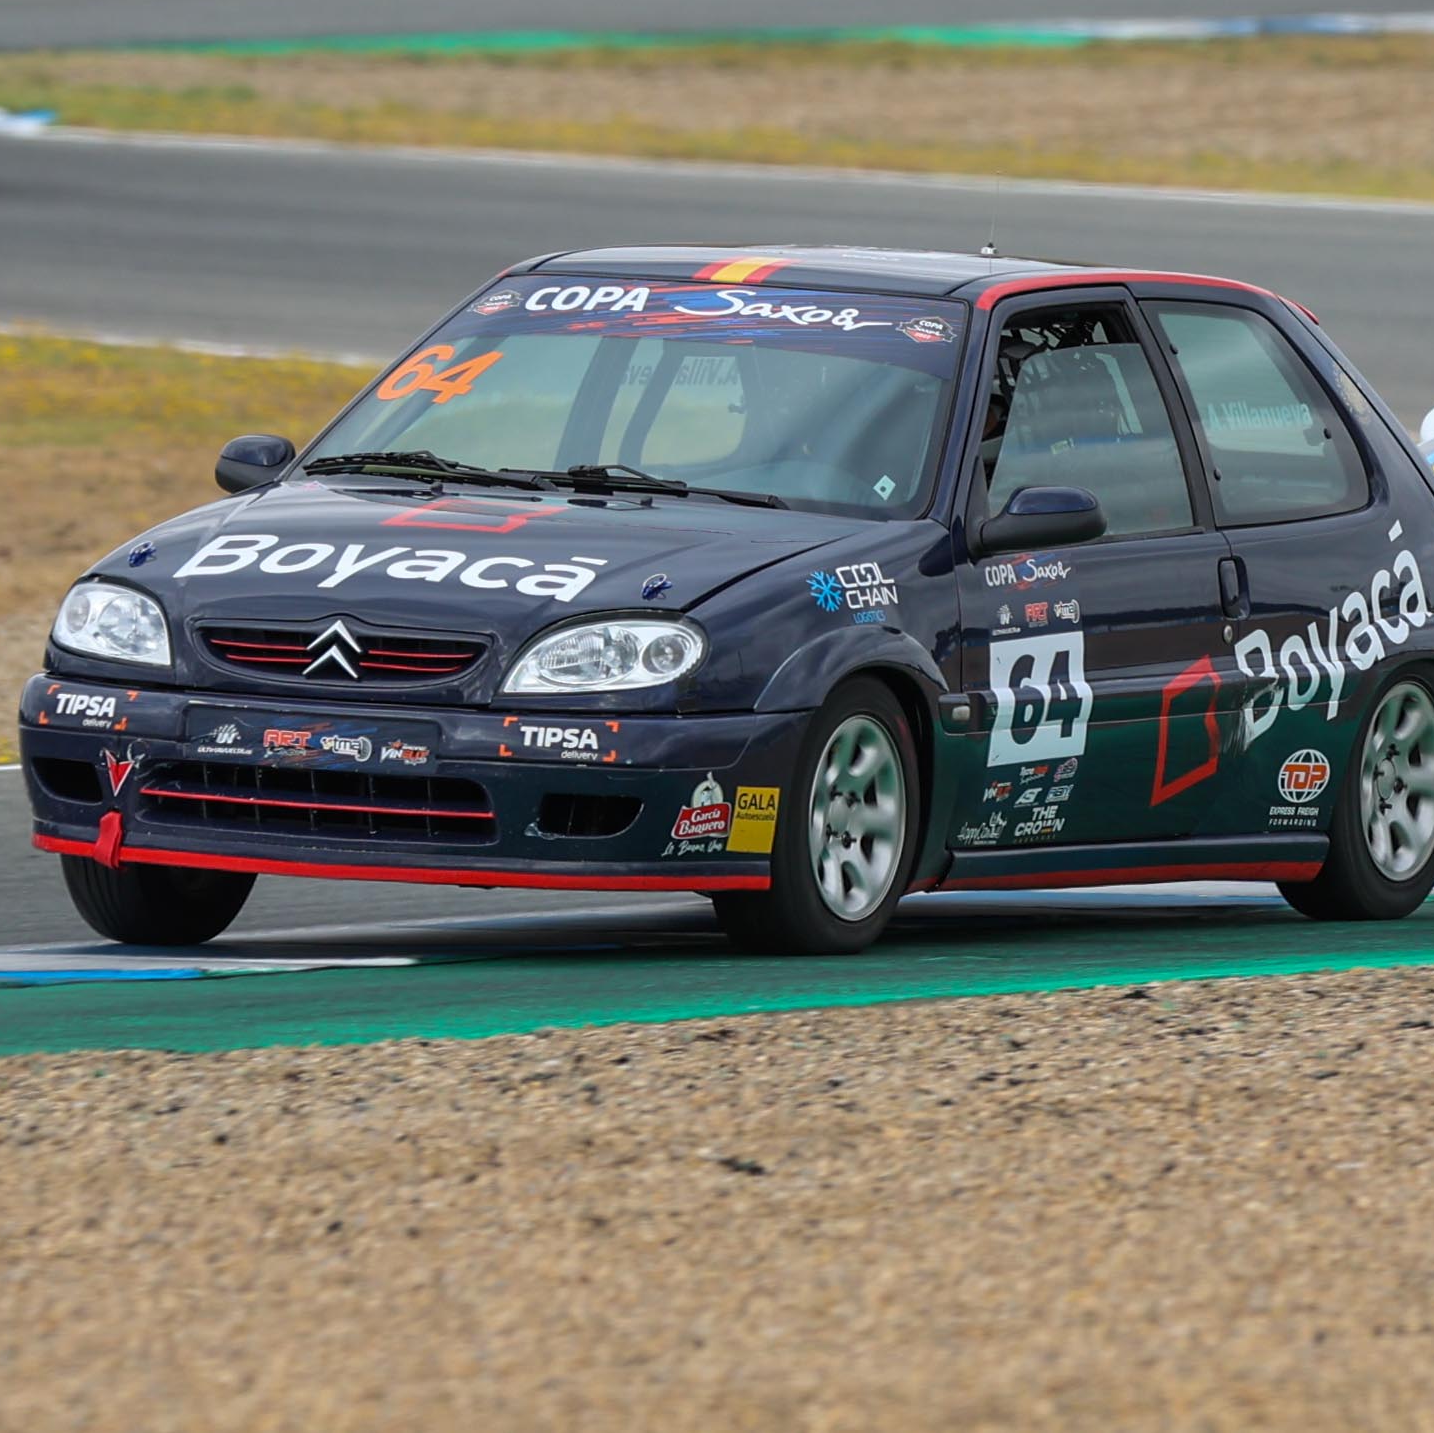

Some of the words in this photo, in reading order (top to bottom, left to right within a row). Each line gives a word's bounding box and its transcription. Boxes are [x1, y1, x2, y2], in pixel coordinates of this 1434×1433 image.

[524, 285, 650, 312] COPA
[376, 344, 504, 405] 64
[172, 534, 609, 603] Boyacá
[835, 561, 895, 588] COOL
[984, 563, 1017, 587] COPA
[845, 585, 899, 609] CHAIN
[1233, 518, 1434, 752] Boyacá
[55, 692, 117, 718] TIPSA
[1007, 649, 1083, 746] 64
[262, 728, 312, 747] ART
[519, 725, 599, 750] TIPSA
[560, 749, 599, 761] delivery
[1282, 763, 1329, 791] TOP
[737, 792, 776, 811] GALA
[1031, 805, 1059, 822] THE
[1269, 806, 1296, 816] EXPRESS
[678, 819, 726, 836] Baquero
[691, 808, 721, 823] García
[1014, 817, 1066, 837] CROWN
